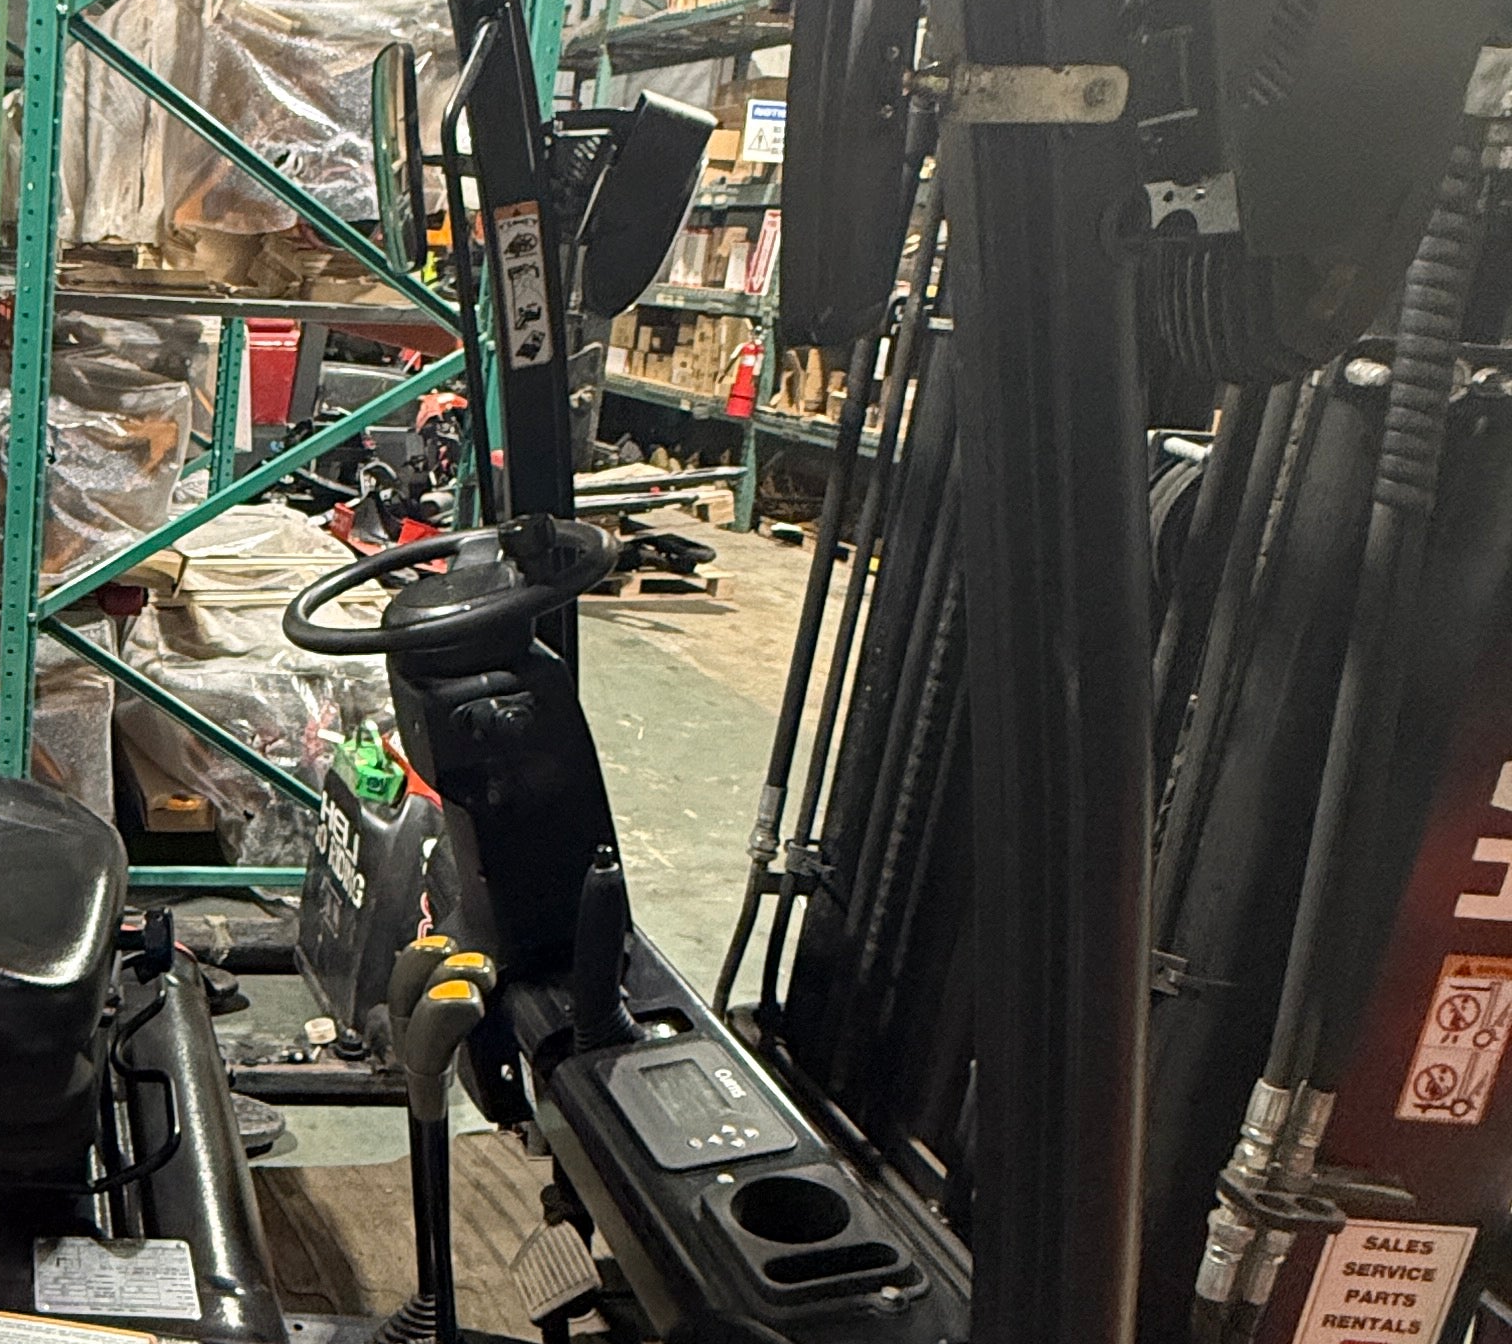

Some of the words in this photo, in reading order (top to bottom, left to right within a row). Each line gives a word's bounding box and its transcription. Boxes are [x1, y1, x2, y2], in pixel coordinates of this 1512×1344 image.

[1362, 1235, 1434, 1255] SALES
[1342, 1261, 1438, 1282] SERVICE
[1344, 1289, 1417, 1307] PARTS
[1321, 1313, 1422, 1334] RENTALS
